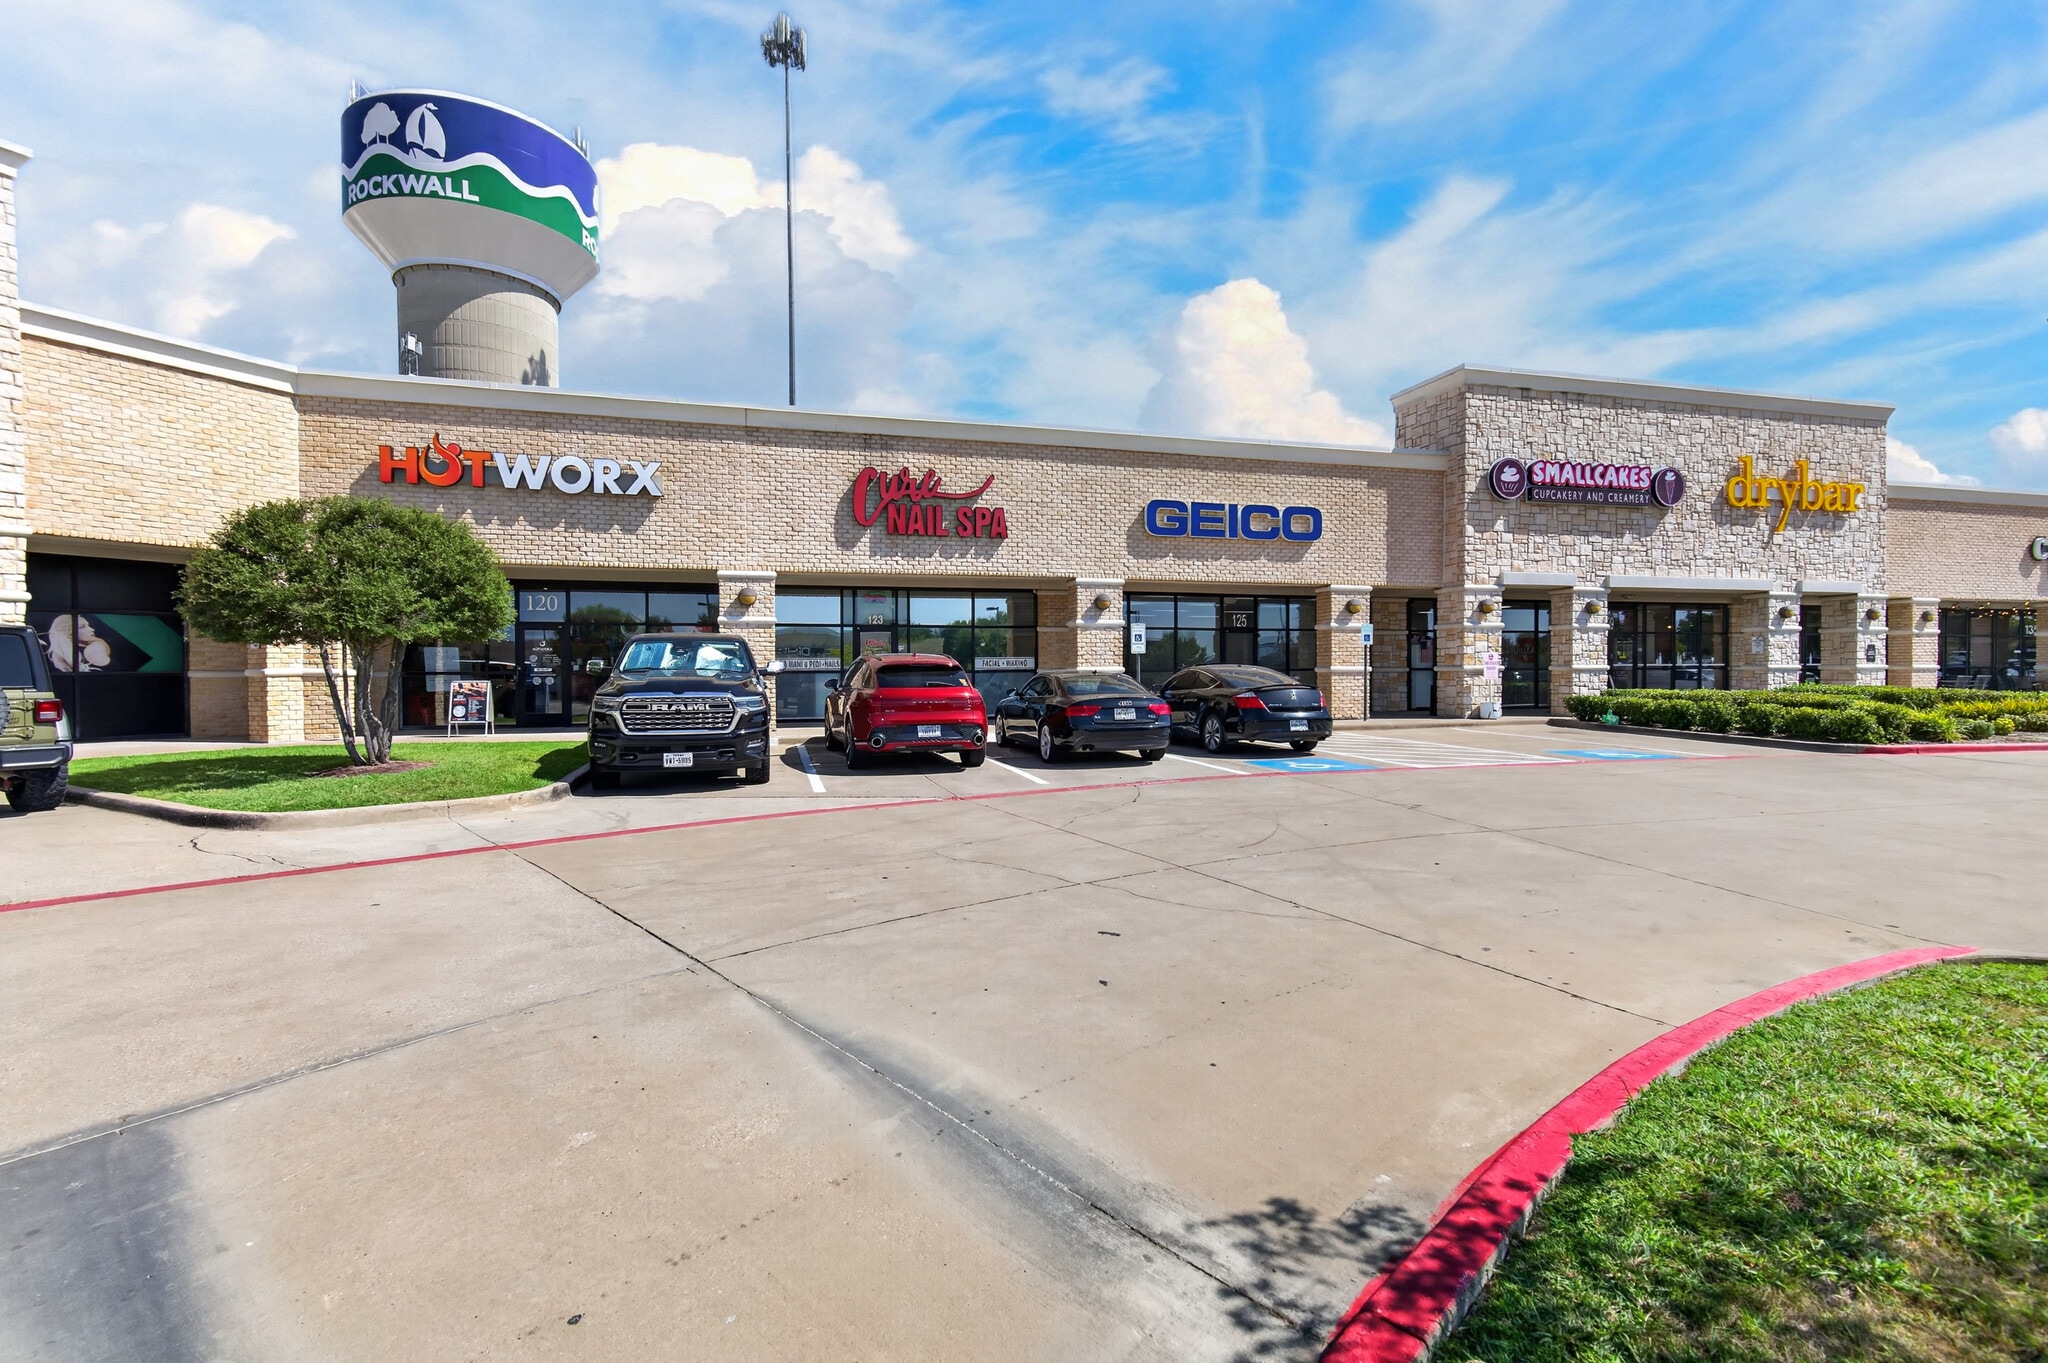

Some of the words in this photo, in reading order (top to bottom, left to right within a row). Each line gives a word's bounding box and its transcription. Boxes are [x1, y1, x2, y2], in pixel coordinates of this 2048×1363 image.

[348, 173, 480, 205] ROCKWALL
[378, 432, 664, 497] HOTWORX
[1531, 459, 1651, 489] SMALLCAKES
[1533, 488, 1583, 501] CUPCAKERY
[1586, 491, 1604, 502] AND
[1607, 492, 1650, 504] CREAMERY
[1726, 455, 1866, 534] drybar
[887, 503, 949, 537] NAIL
[956, 505, 1009, 539] SPA
[1144, 499, 1323, 542] GEICO
[526, 595, 558, 612] 120
[867, 614, 884, 625] 123
[1232, 614, 1247, 628] 125
[982, 659, 1001, 667] FACIAL
[651, 703, 705, 711] RAM
